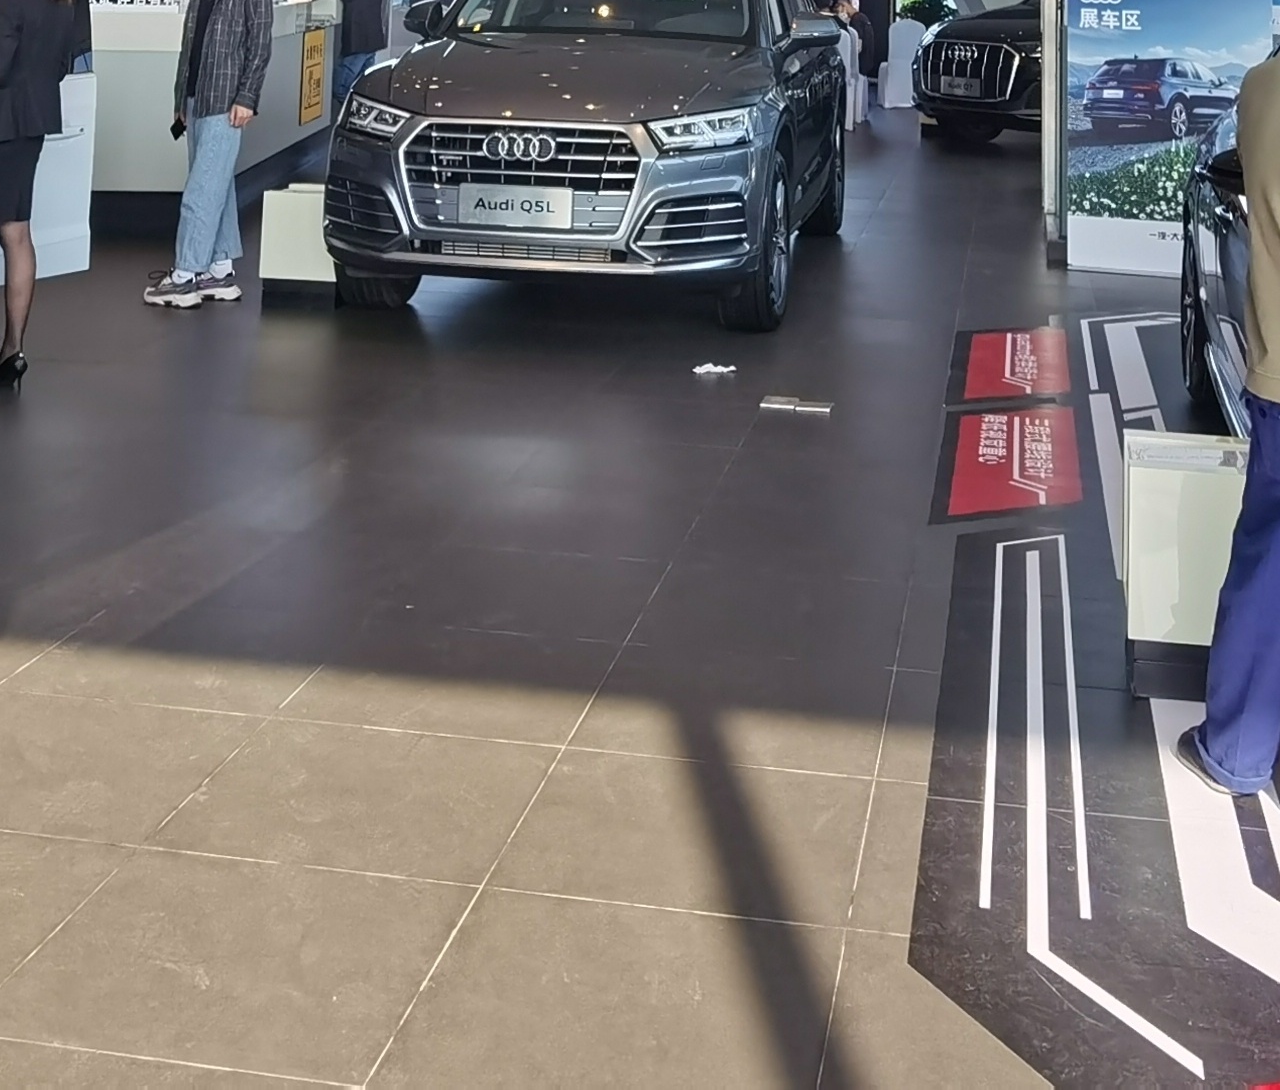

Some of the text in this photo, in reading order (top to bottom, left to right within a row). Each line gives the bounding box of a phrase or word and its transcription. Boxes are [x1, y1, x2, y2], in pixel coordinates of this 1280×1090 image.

[1079, 8, 1142, 30] 展车区
[474, 198, 555, 214] Audi Q5L
